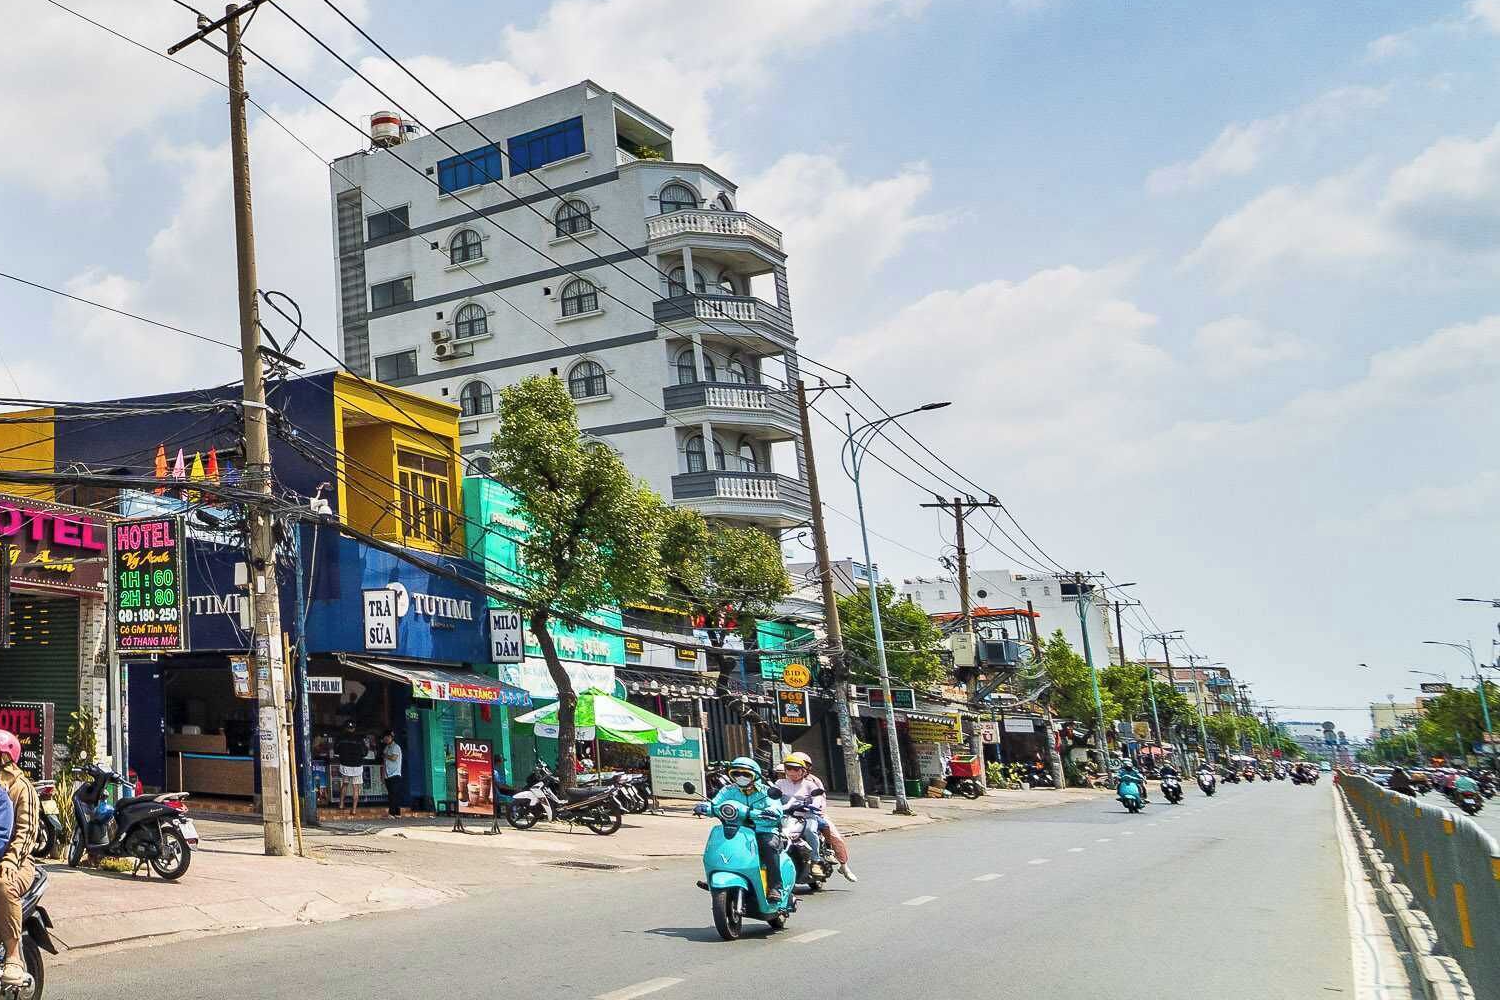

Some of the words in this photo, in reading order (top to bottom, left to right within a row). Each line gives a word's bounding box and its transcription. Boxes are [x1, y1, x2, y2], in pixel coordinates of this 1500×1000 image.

[116, 521, 174, 550] HOTEL
[120, 571, 140, 588] 1H
[153, 569, 174, 586] 60
[120, 590, 140, 607] 2H
[154, 588, 174, 605] 80
[369, 596, 392, 617] TRÀ
[412, 593, 473, 621] TUTIMI
[493, 613, 518, 630] MILO
[133, 637, 159, 646] THANG
[160, 634, 177, 646] MÁY
[370, 623, 392, 644] SỮA
[495, 633, 519, 656] DẦM
[460, 743, 488, 752] MILO
